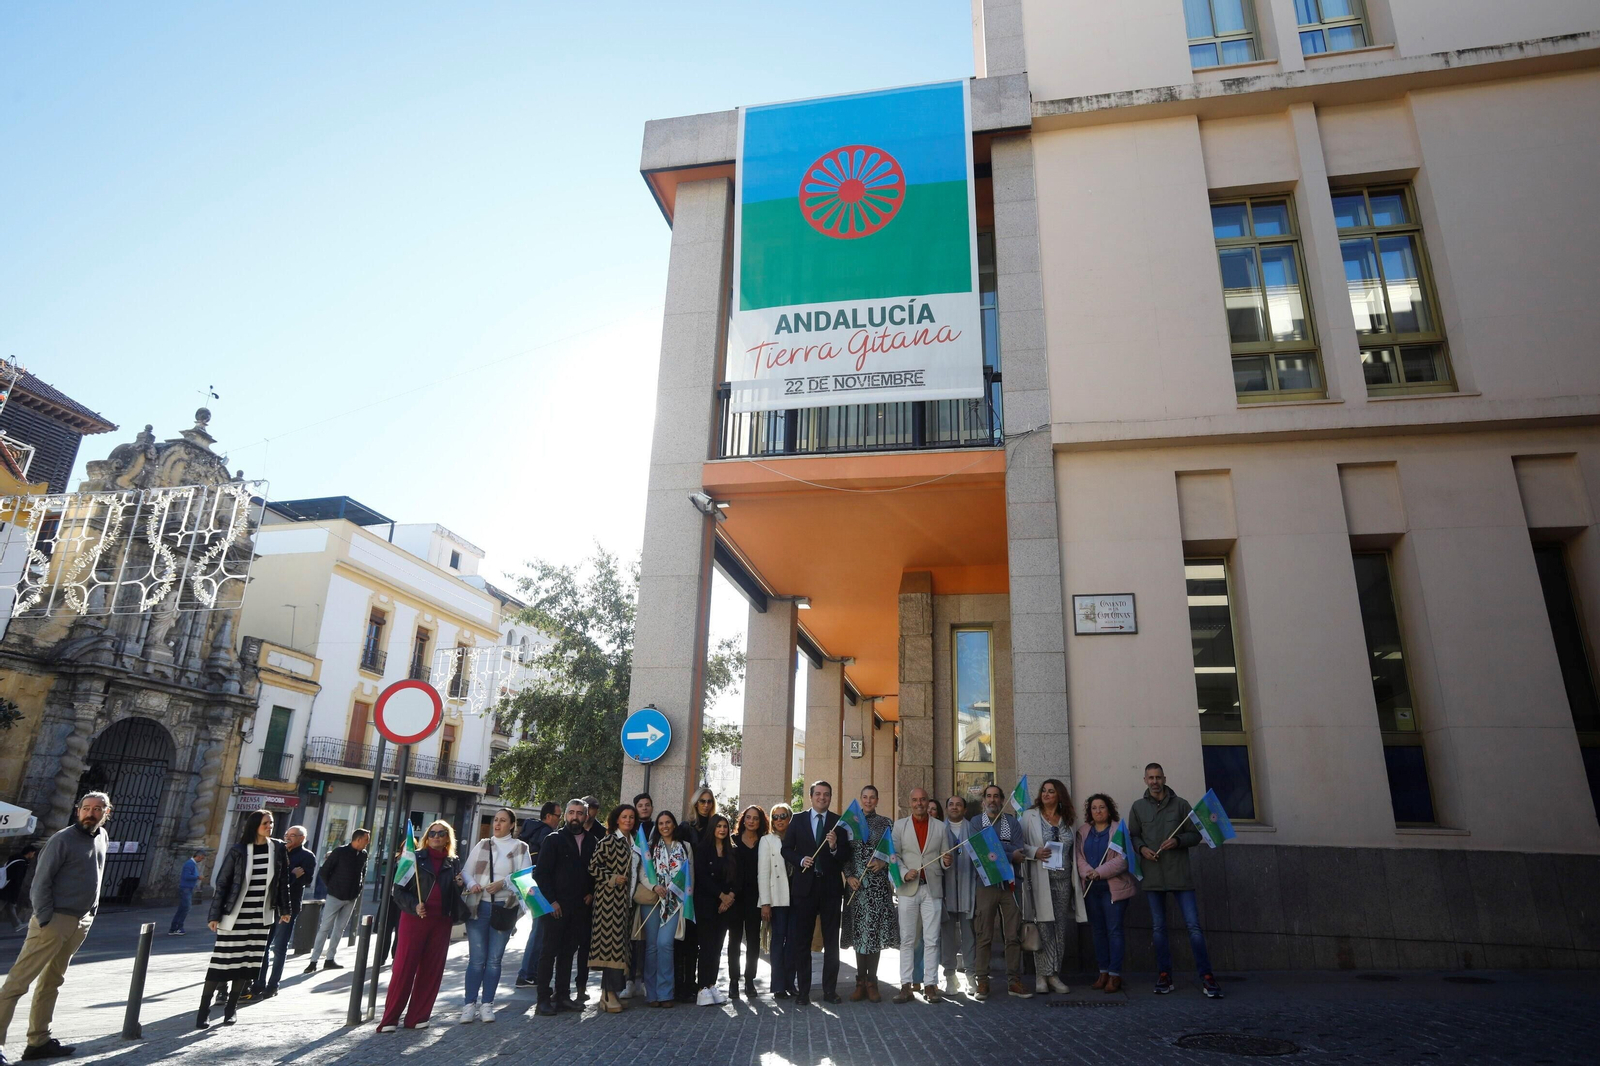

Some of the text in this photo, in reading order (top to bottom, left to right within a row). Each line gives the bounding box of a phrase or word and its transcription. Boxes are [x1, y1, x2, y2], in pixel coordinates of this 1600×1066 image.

[774, 298, 936, 335] ANDALUCÍA
[745, 325, 962, 378] Tierra Gitana
[785, 371, 924, 393] 22 DE NOVIEMBRE
